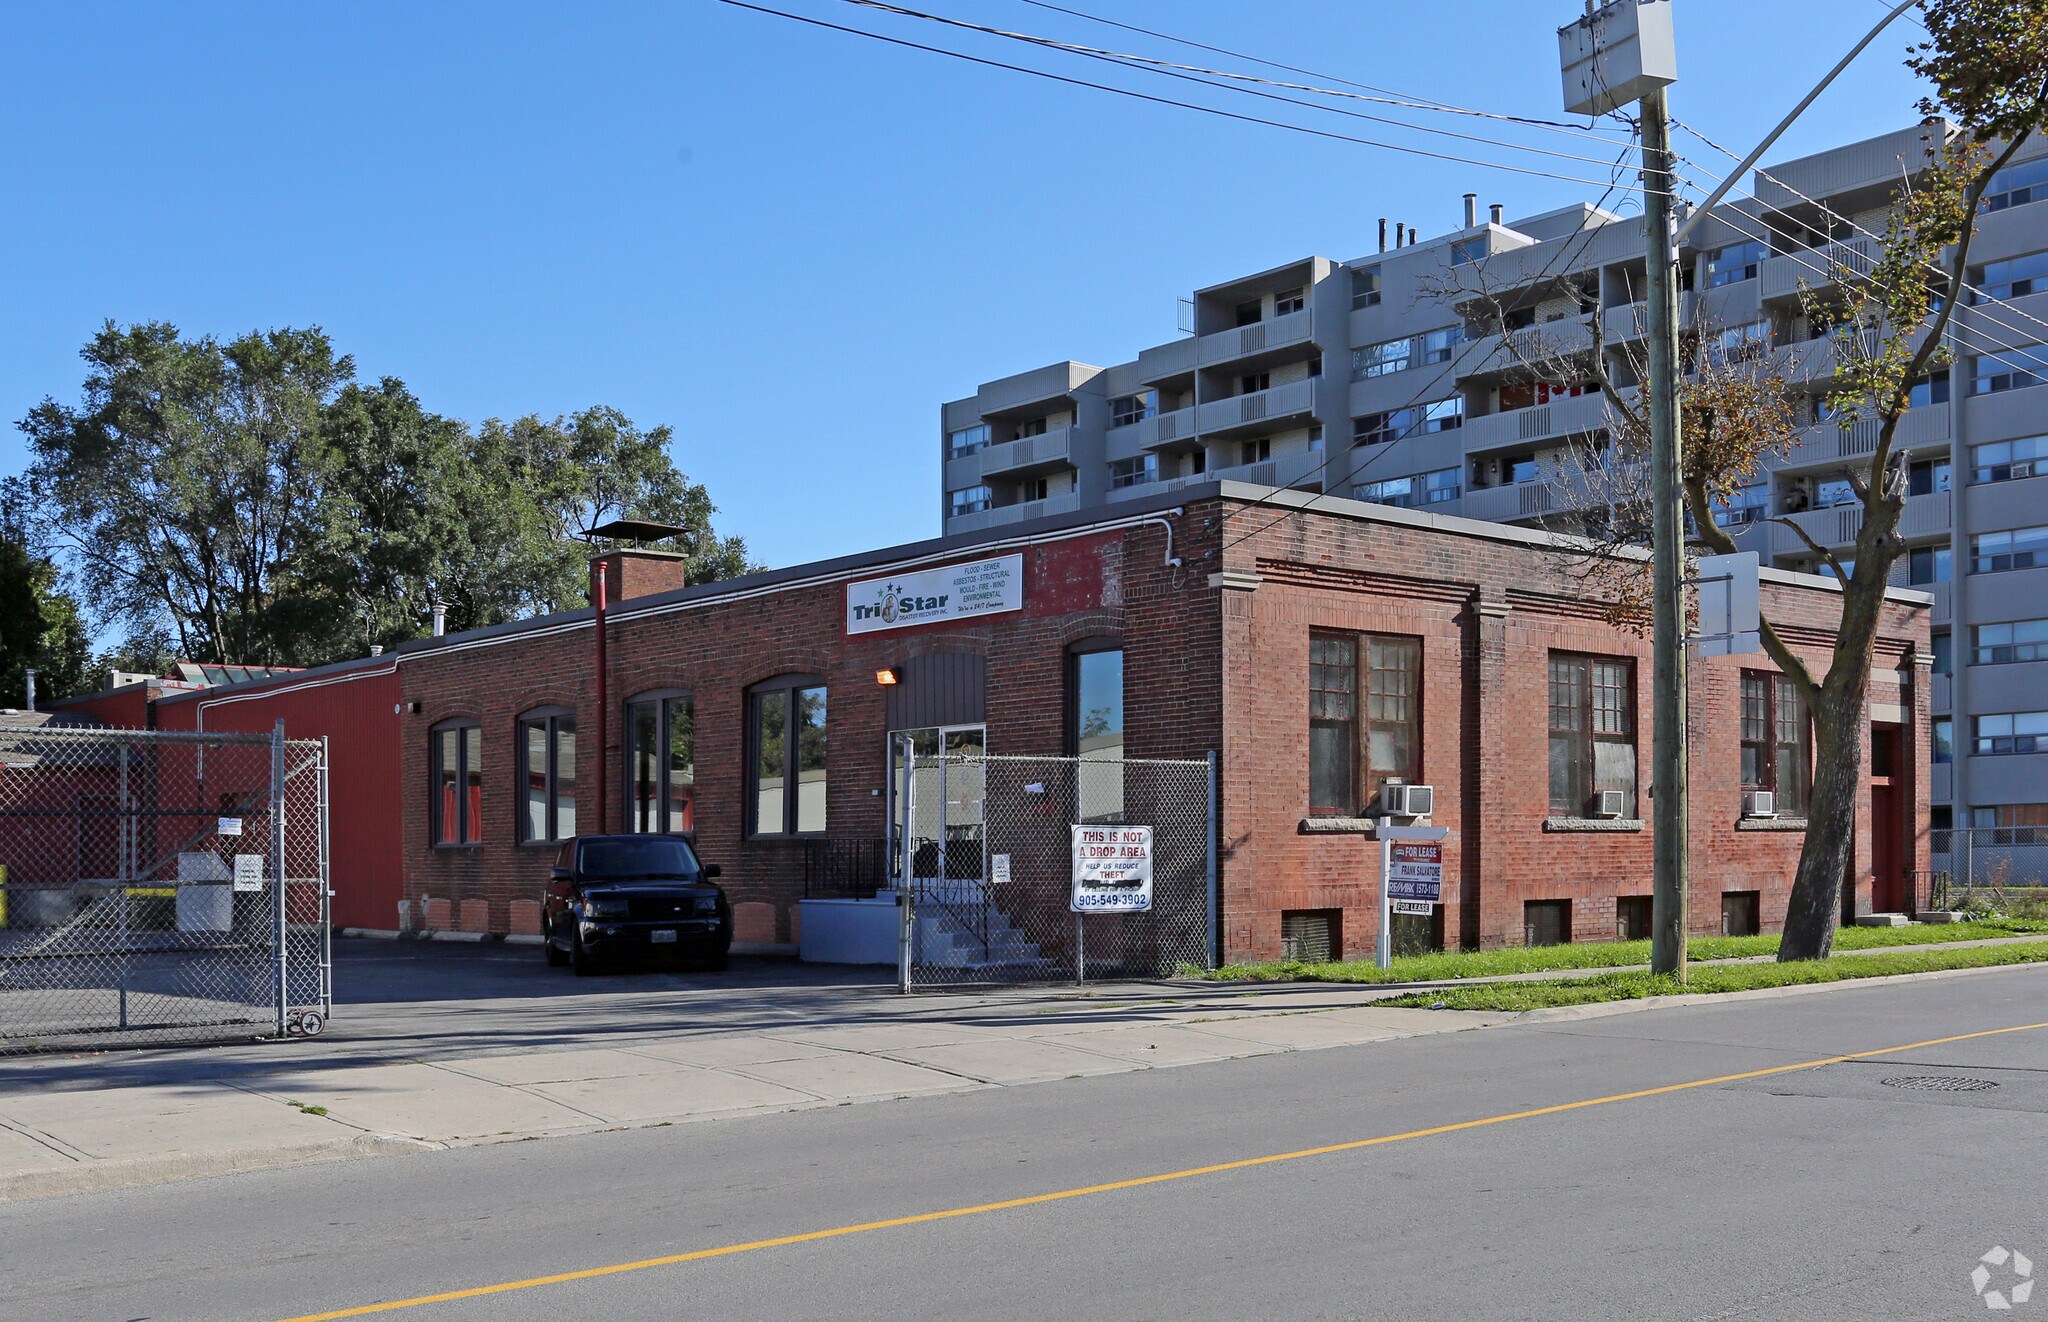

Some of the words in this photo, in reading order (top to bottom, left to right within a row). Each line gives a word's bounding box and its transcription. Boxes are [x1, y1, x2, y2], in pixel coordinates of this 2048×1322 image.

[964, 566, 980, 574] FLOOD
[983, 562, 1000, 571] SEWER
[953, 575, 976, 586] ASBESTOS
[980, 570, 1010, 581] STRUCTURAL
[959, 585, 975, 594] MOULD
[978, 583, 989, 591] FIRE
[993, 580, 1005, 589] WIND
[963, 591, 1001, 602] ENVIRONMENTAL
[853, 602, 880, 620] Tri
[899, 594, 949, 614] Star
[918, 610, 939, 618] RECOVERY
[1083, 832, 1104, 842] THIS
[1110, 832, 1118, 842] IS
[1123, 832, 1142, 842] NOT
[1080, 847, 1086, 857] A
[1090, 847, 1116, 857] DROP
[1120, 847, 1146, 857] AREA
[1405, 847, 1418, 857] FOR
[1419, 847, 1437, 857] LEASE
[1100, 871, 1125, 879] THEFT
[1401, 865, 1416, 876] FRANK
[1417, 866, 1440, 877] SALVATORE
[1389, 882, 1415, 893] RE/MAX
[1397, 903, 1409, 911] FOR
[1410, 904, 1428, 912] LEASE
